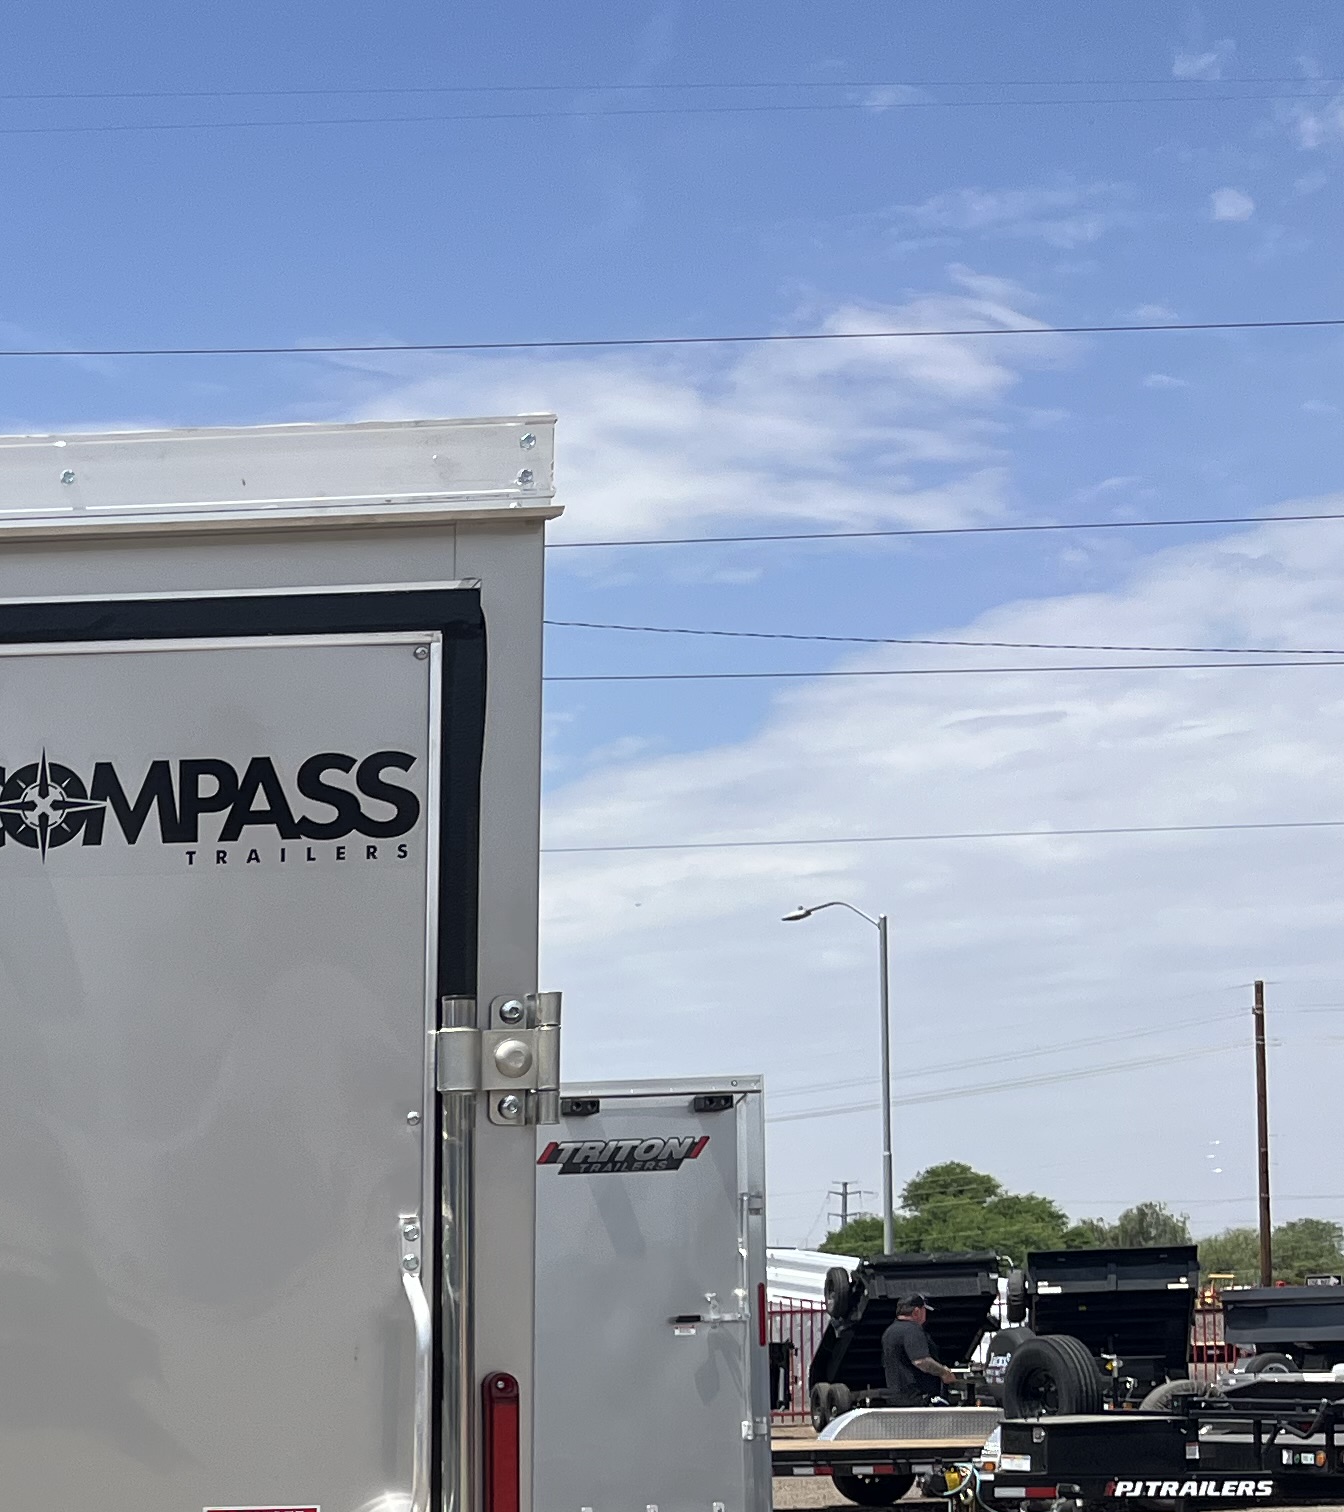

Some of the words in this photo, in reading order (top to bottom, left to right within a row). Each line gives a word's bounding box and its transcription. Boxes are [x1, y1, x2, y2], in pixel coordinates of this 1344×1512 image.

[186, 843, 409, 866] TRAILERS
[556, 1136, 695, 1164] TRITON
[579, 1160, 668, 1174] TRAILERS
[1114, 1480, 1144, 1497] PJ
[1147, 1480, 1274, 1497] TRAILERS
